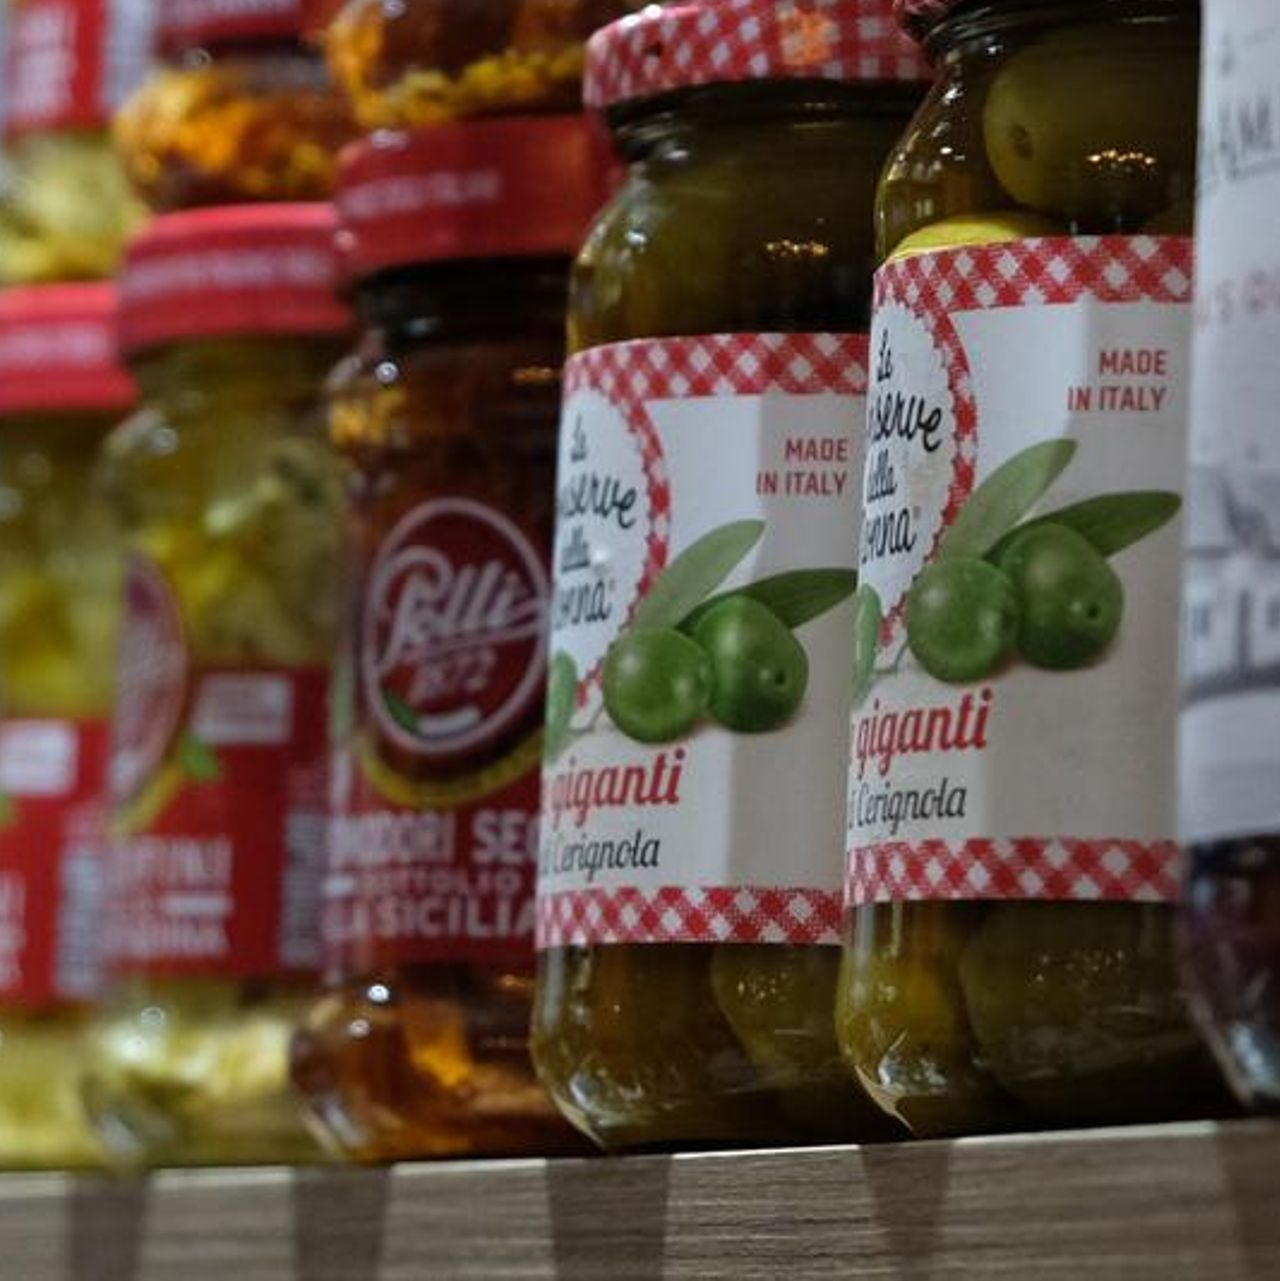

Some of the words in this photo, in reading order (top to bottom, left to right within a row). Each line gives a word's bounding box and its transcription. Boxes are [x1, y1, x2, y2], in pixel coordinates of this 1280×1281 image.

[1099, 349, 1169, 375] MADE
[1067, 385, 1091, 411] IN
[1099, 385, 1167, 412] ITALY
[785, 437, 848, 462] MADE
[757, 470, 778, 495] IN
[785, 471, 848, 496] ITALY
[856, 688, 993, 780] giganti
[856, 777, 967, 836] Cerignola
